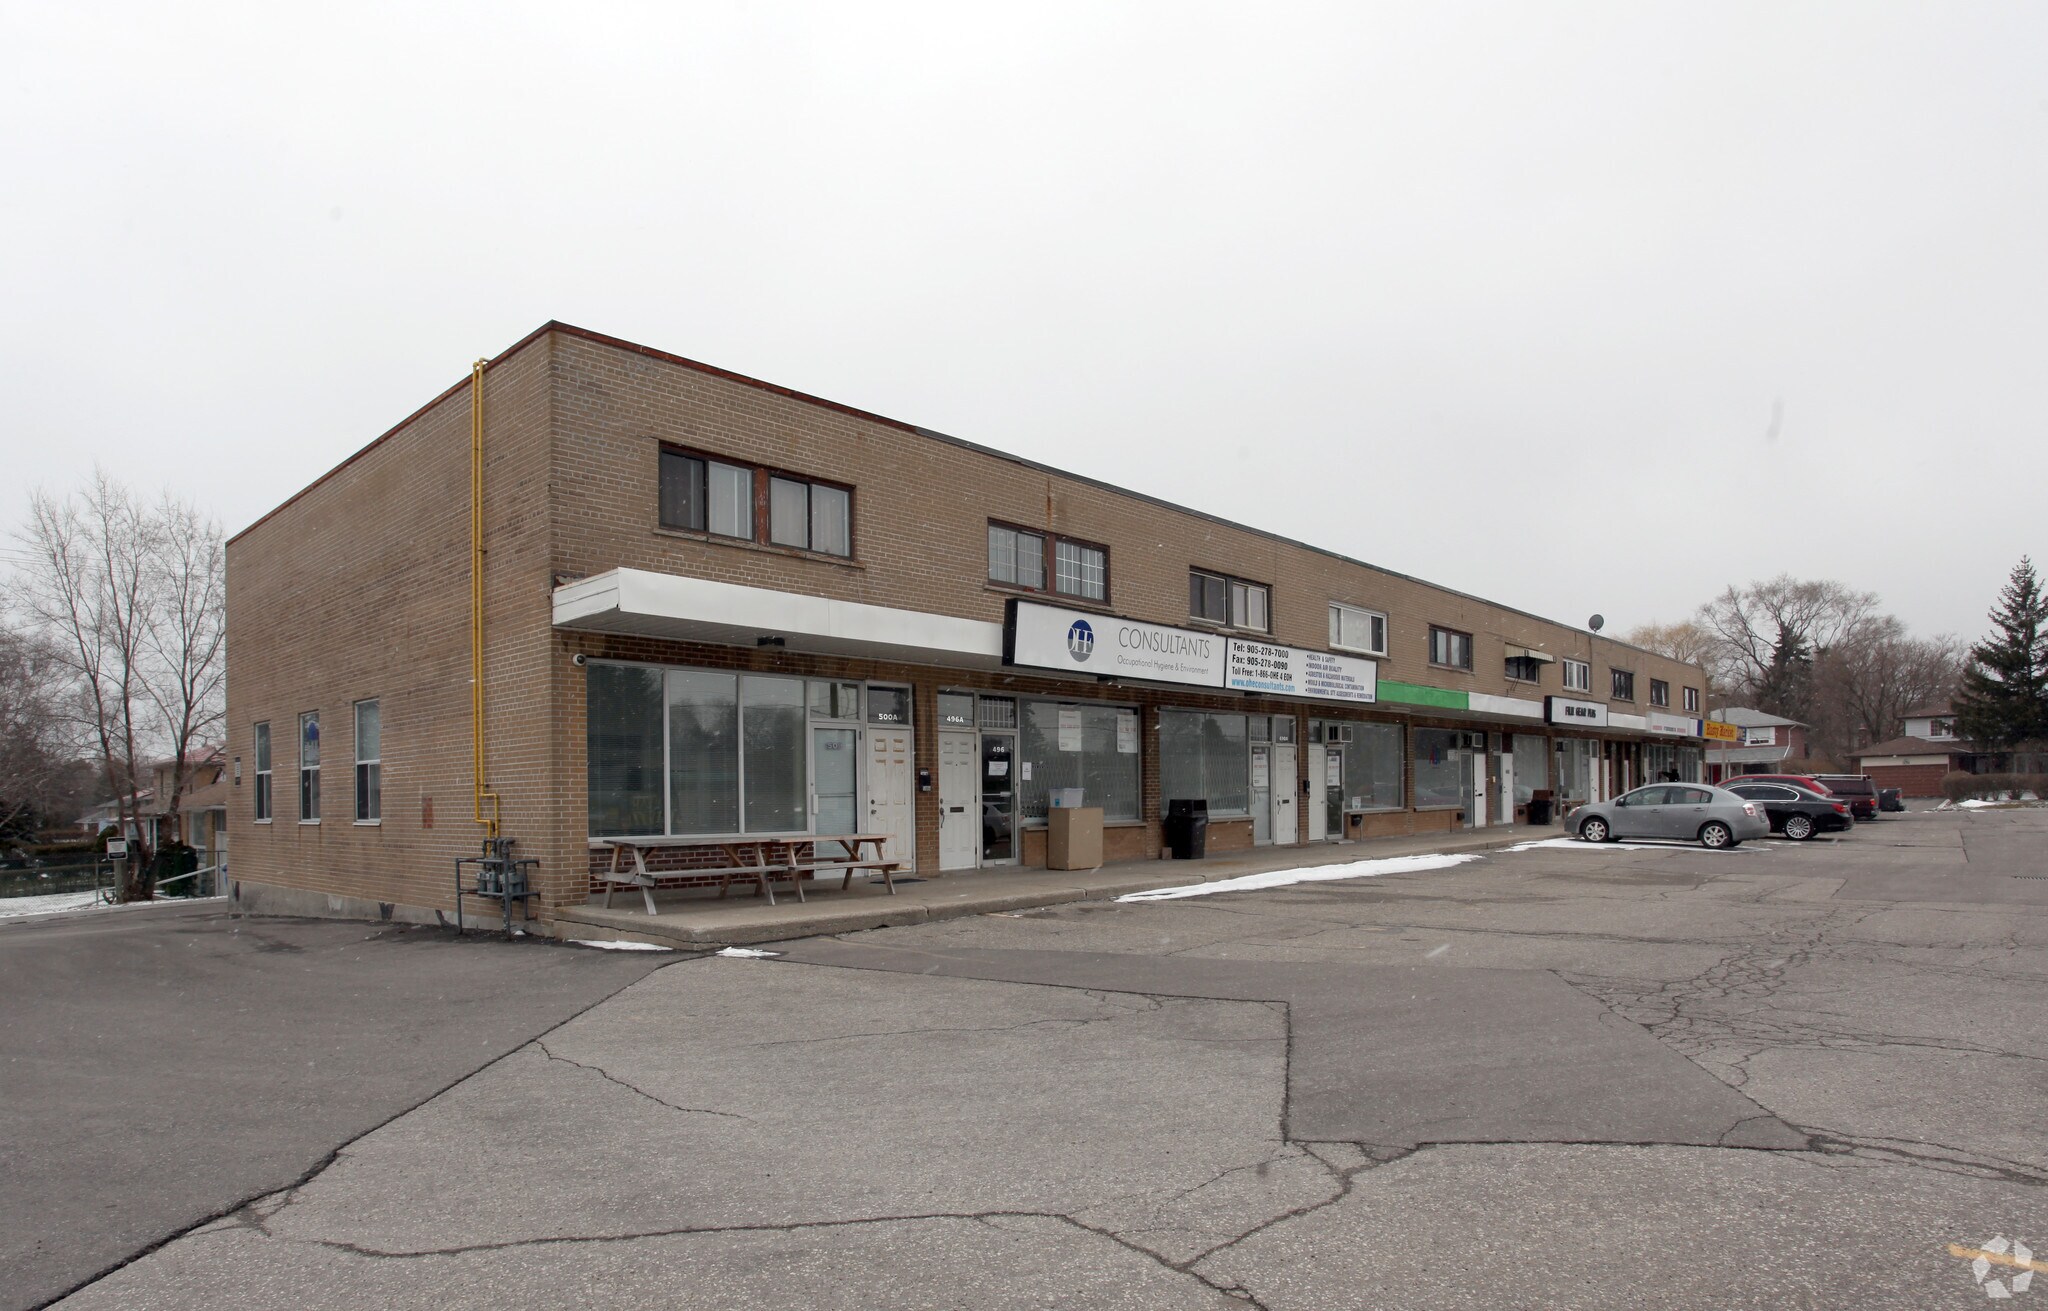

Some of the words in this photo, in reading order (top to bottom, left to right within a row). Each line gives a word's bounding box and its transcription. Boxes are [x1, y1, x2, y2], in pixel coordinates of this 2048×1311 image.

[1118, 627, 1210, 659] CONSULTANTS
[1233, 642, 1245, 652] Tel:
[1247, 645, 1289, 659] 905-278-7000
[1117, 655, 1153, 668] Occupational
[1154, 660, 1174, 672] Hygiene
[1175, 663, 1179, 671] &
[1180, 663, 1209, 675] Environment
[1232, 654, 1245, 664] Fax:
[1247, 656, 1288, 670] 905-278-0090
[1232, 666, 1241, 675] Toll
[1242, 668, 1254, 677] Free:
[1231, 678, 1296, 692] www.oheconsultants.com
[878, 713, 898, 721] 500A
[946, 715, 964, 723] 496A
